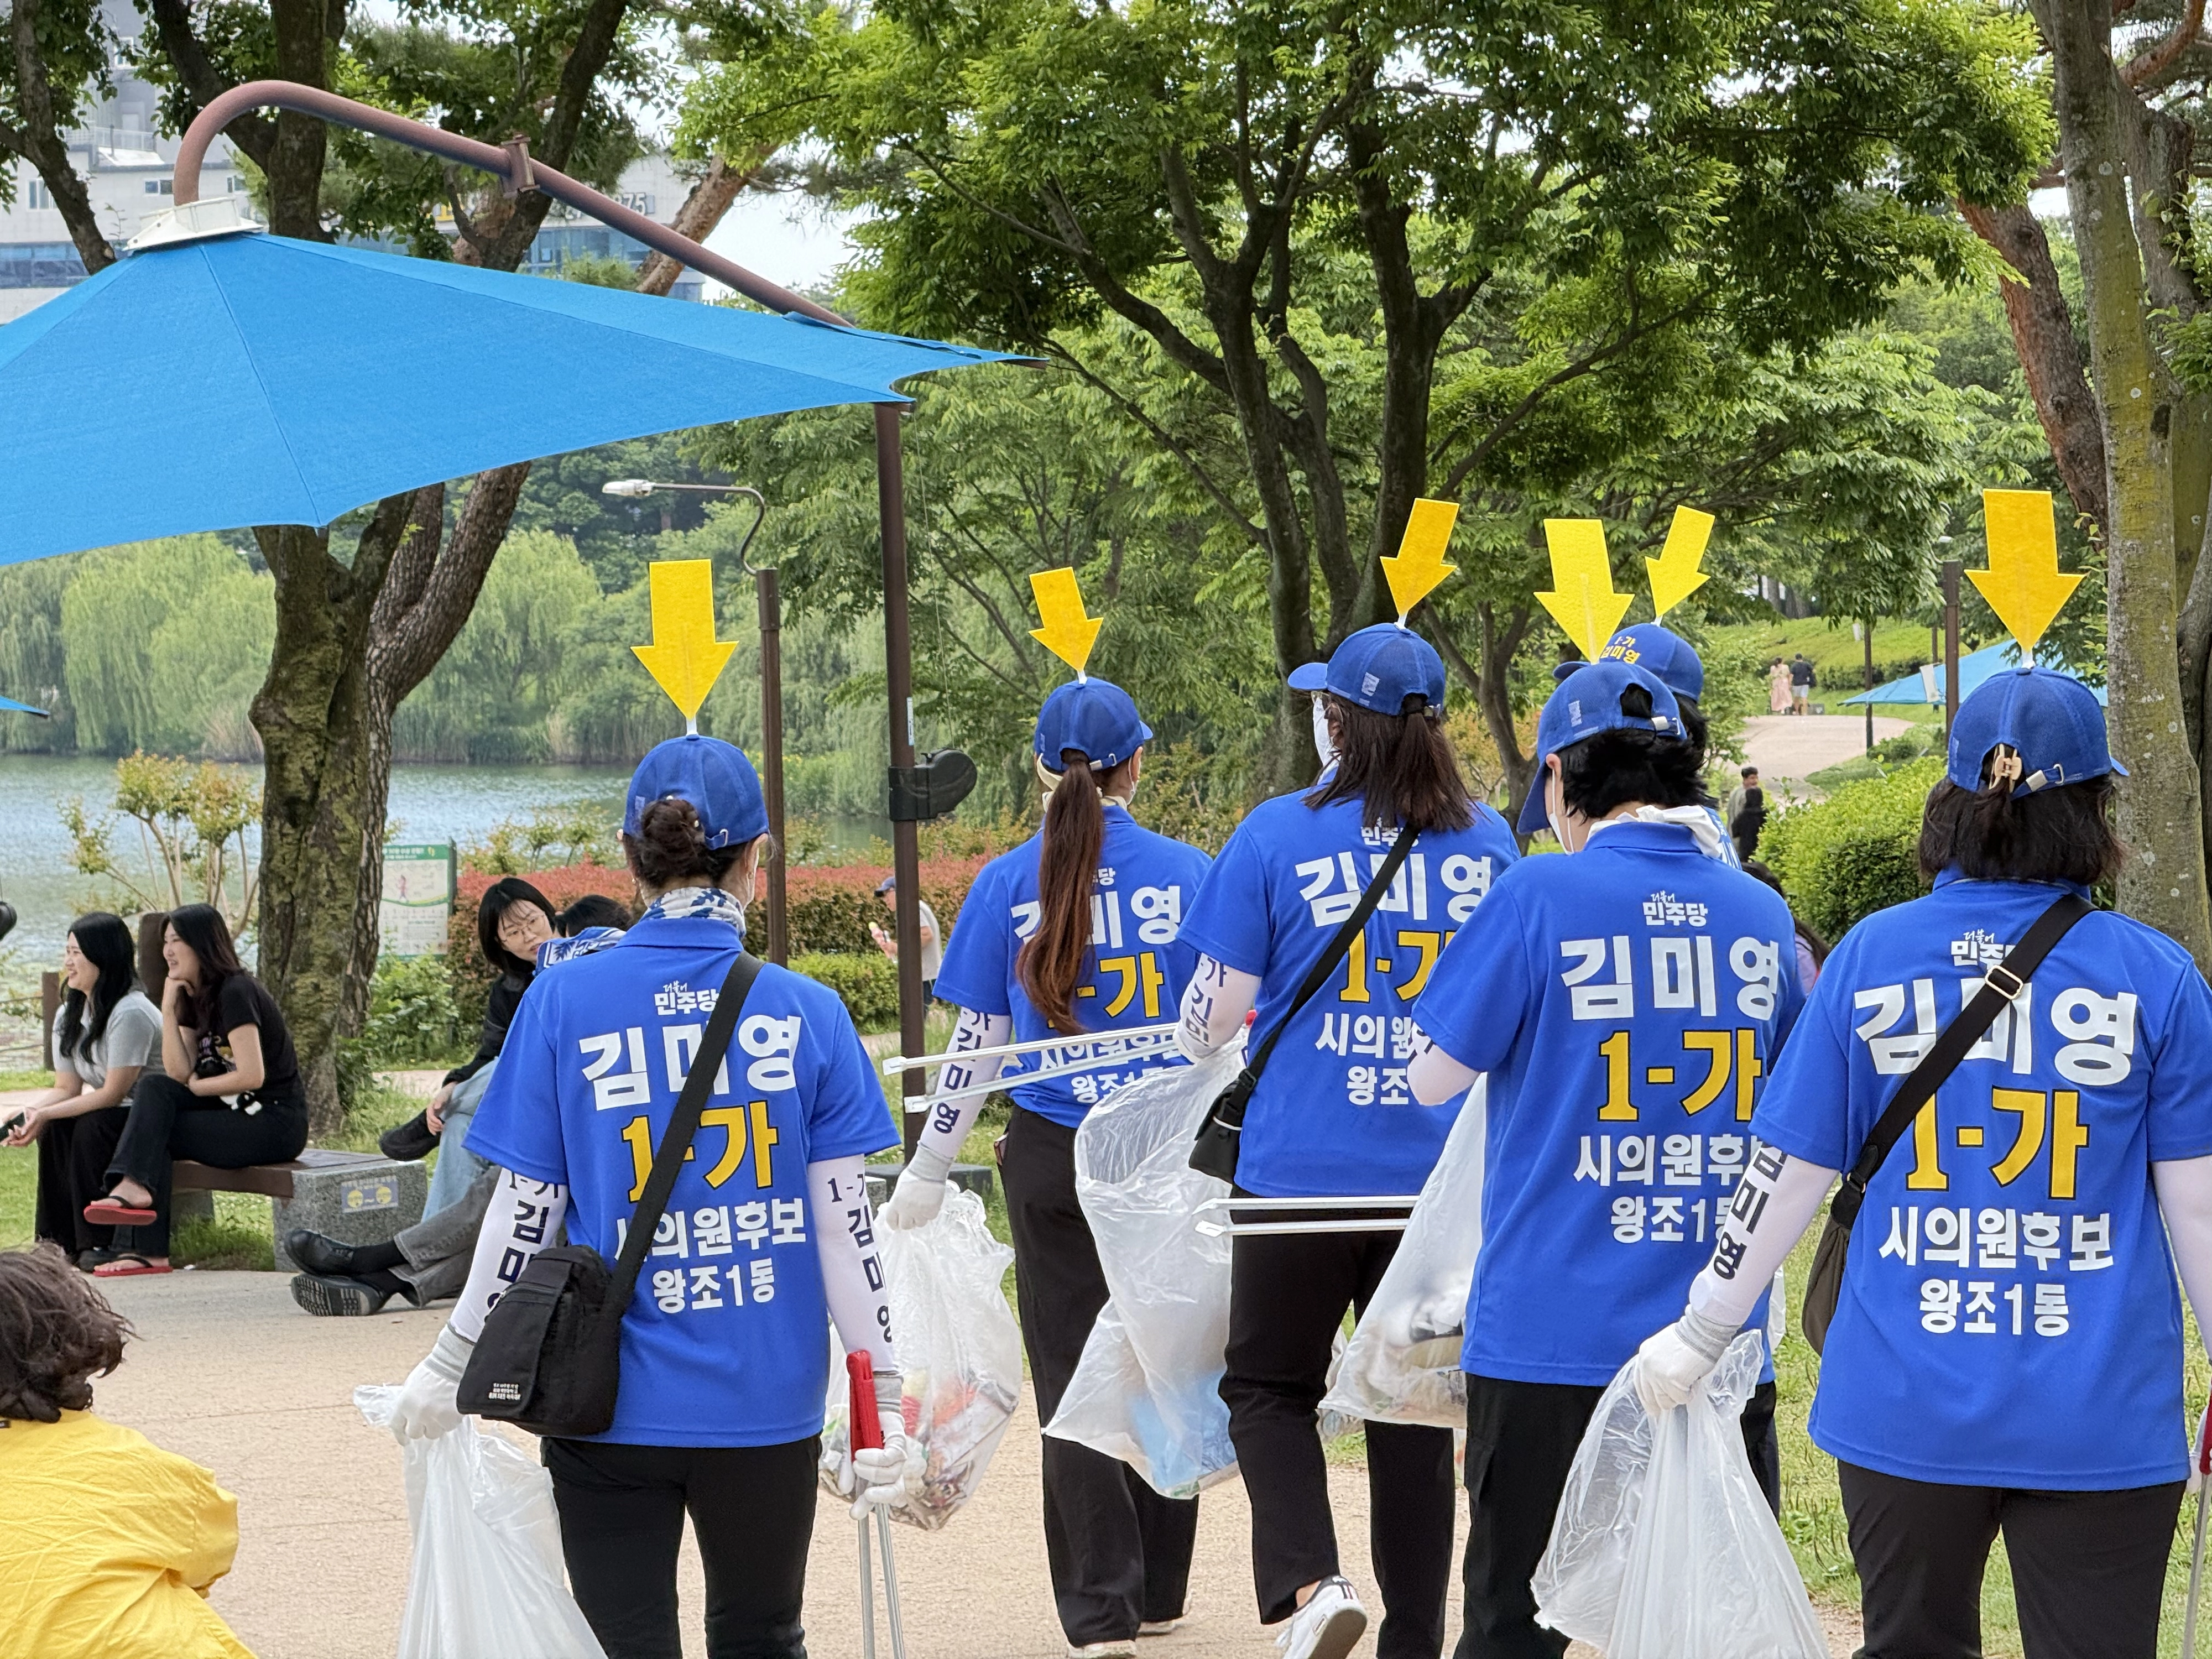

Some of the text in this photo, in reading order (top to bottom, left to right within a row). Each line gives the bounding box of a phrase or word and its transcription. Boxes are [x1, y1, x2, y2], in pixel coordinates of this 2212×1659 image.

[1360, 826, 1421, 847] 민주
[1295, 852, 1491, 927] 김미영
[1642, 902, 1708, 927] 민주당
[1561, 936, 1779, 1020] 김미영
[1951, 940, 2016, 971] 민주
[654, 989, 720, 1016] 민주당
[1854, 977, 2138, 1086] 김미영
[1598, 1027, 1762, 1122] 1-가
[1573, 1134, 1763, 1187] 시의원후
[1906, 1086, 2090, 1200] 1-가
[487, 1199, 550, 1310] 김미
[1879, 1206, 2114, 1271] 시의원후보
[653, 1258, 775, 1314] 왕조1동
[1919, 1278, 2069, 1336] 왕조1동
